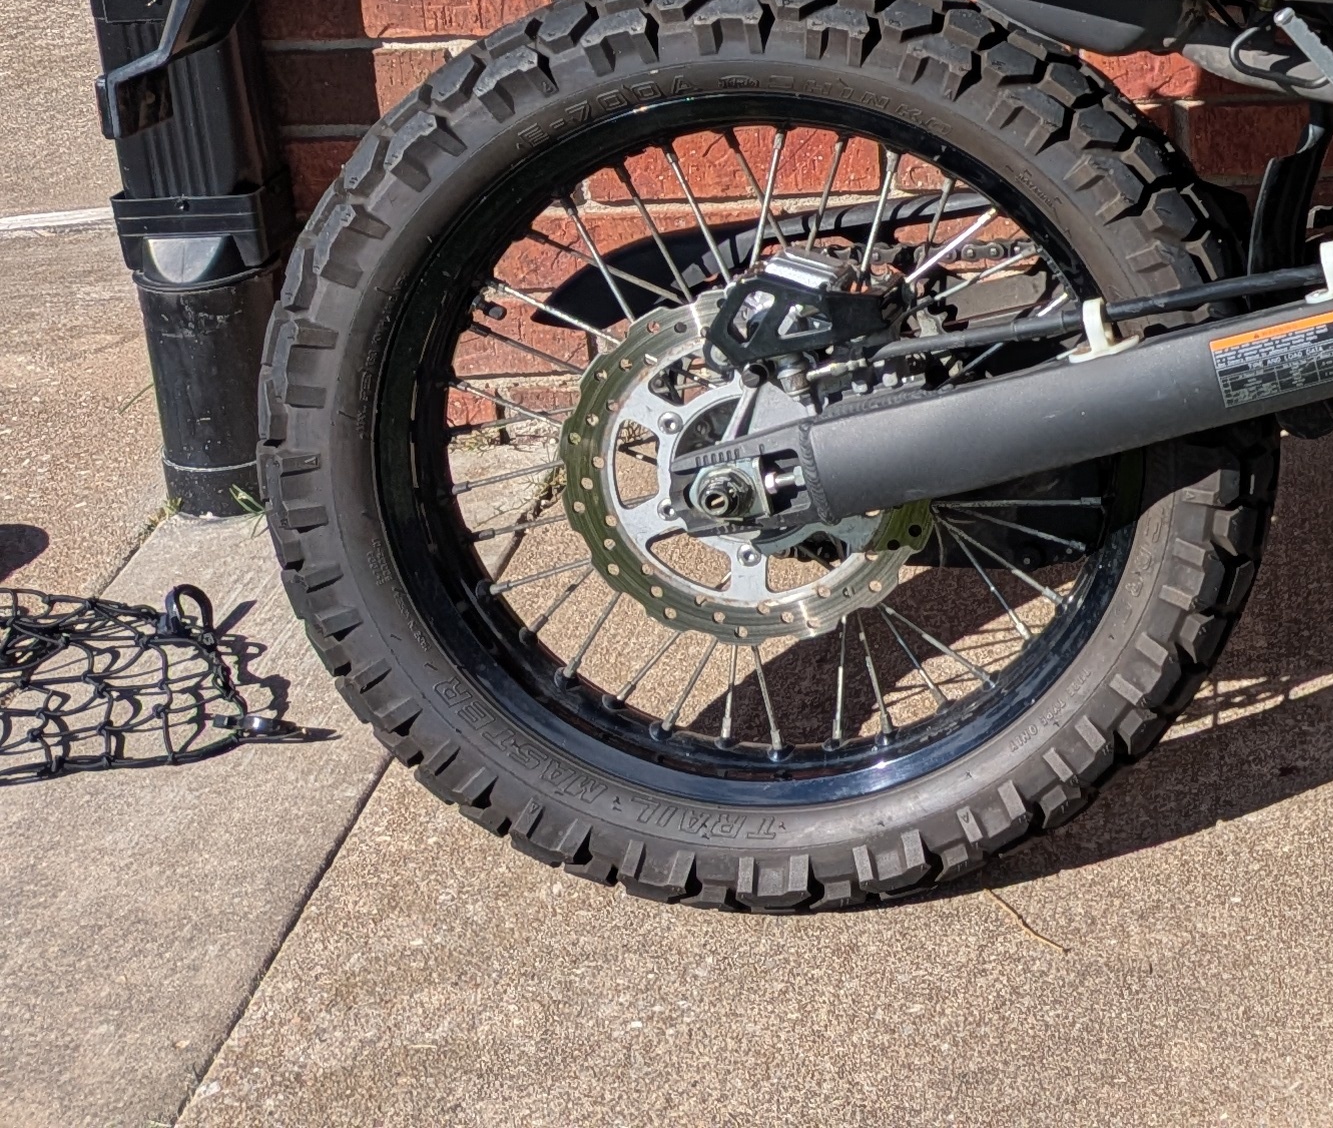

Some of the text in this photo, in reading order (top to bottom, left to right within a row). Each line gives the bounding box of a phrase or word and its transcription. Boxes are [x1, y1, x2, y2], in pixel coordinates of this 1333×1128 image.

[518, 74, 702, 149] E-700A
[766, 75, 952, 138] SHINKO
[1265, 355, 1281, 365] AND
[1283, 350, 1303, 361] LOAD
[1304, 345, 1323, 355] DATA
[1035, 696, 1069, 728] TYPE
[432, 676, 779, 841] TRAIL MASTER
[1003, 722, 1041, 753] ONLY
